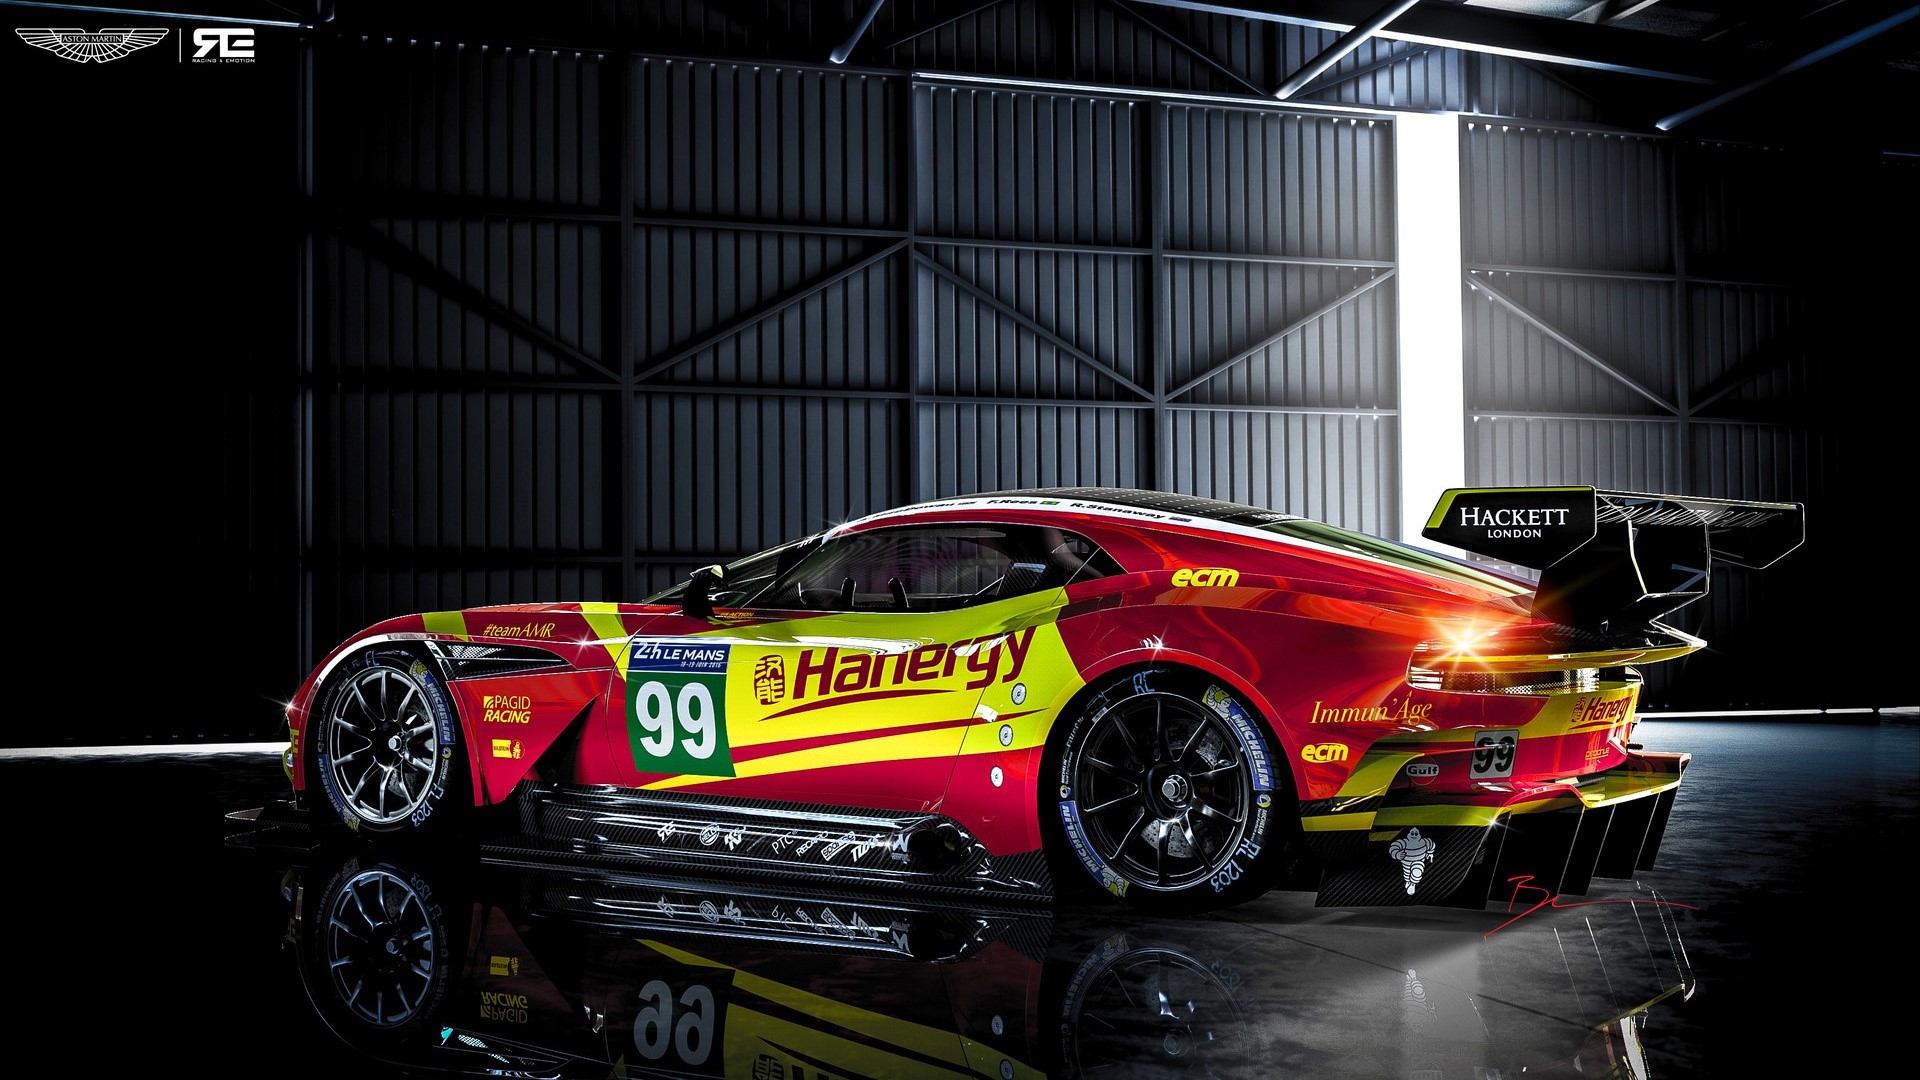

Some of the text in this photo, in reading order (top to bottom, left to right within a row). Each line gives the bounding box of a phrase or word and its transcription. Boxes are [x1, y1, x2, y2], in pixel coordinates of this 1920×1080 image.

[1070, 502, 1166, 519] R.Stanaway
[1460, 507, 1569, 526] HACKETT
[1487, 529, 1542, 539] LONDON
[1171, 567, 1240, 587] ecm
[483, 622, 555, 639] #teamAMR
[663, 649, 682, 660] LE
[682, 650, 725, 661] MANS
[793, 625, 1039, 700] Hanergy
[427, 683, 453, 742] MICHELIN
[494, 695, 531, 710] PAGID
[484, 710, 532, 724] RACING
[636, 680, 717, 760] 99
[1230, 714, 1271, 788] MICHELIN
[1301, 743, 1349, 763] ecm
[1472, 737, 1516, 774] 99
[1407, 765, 1439, 775] Gulf
[319, 757, 343, 813] MICHELIN
[411, 799, 433, 827] 1203
[771, 833, 795, 855] PTC
[1062, 803, 1101, 873] MICHELIN
[1210, 857, 1243, 893] 1203
